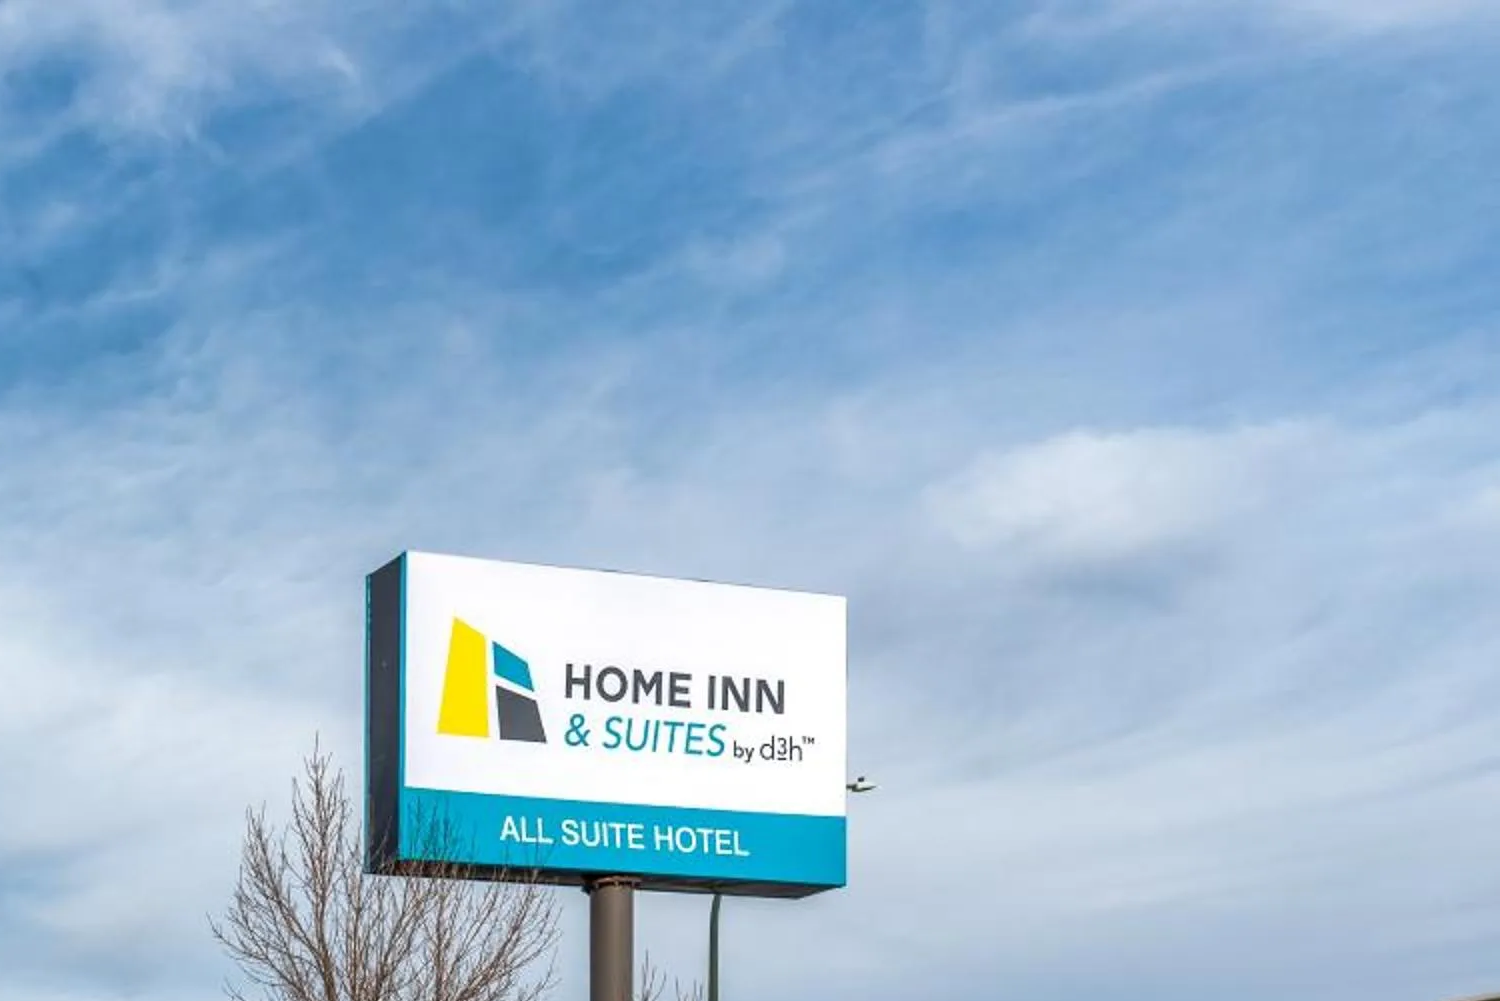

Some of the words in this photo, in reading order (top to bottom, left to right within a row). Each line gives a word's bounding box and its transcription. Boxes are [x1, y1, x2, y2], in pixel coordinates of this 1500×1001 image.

[565, 663, 692, 708] HOME
[708, 675, 785, 715] INN
[564, 713, 591, 747] &
[602, 716, 727, 758] SUITES
[733, 740, 754, 763] by
[500, 815, 554, 844] ALL
[561, 819, 645, 849] SUITE
[654, 825, 750, 857] HOTEL
